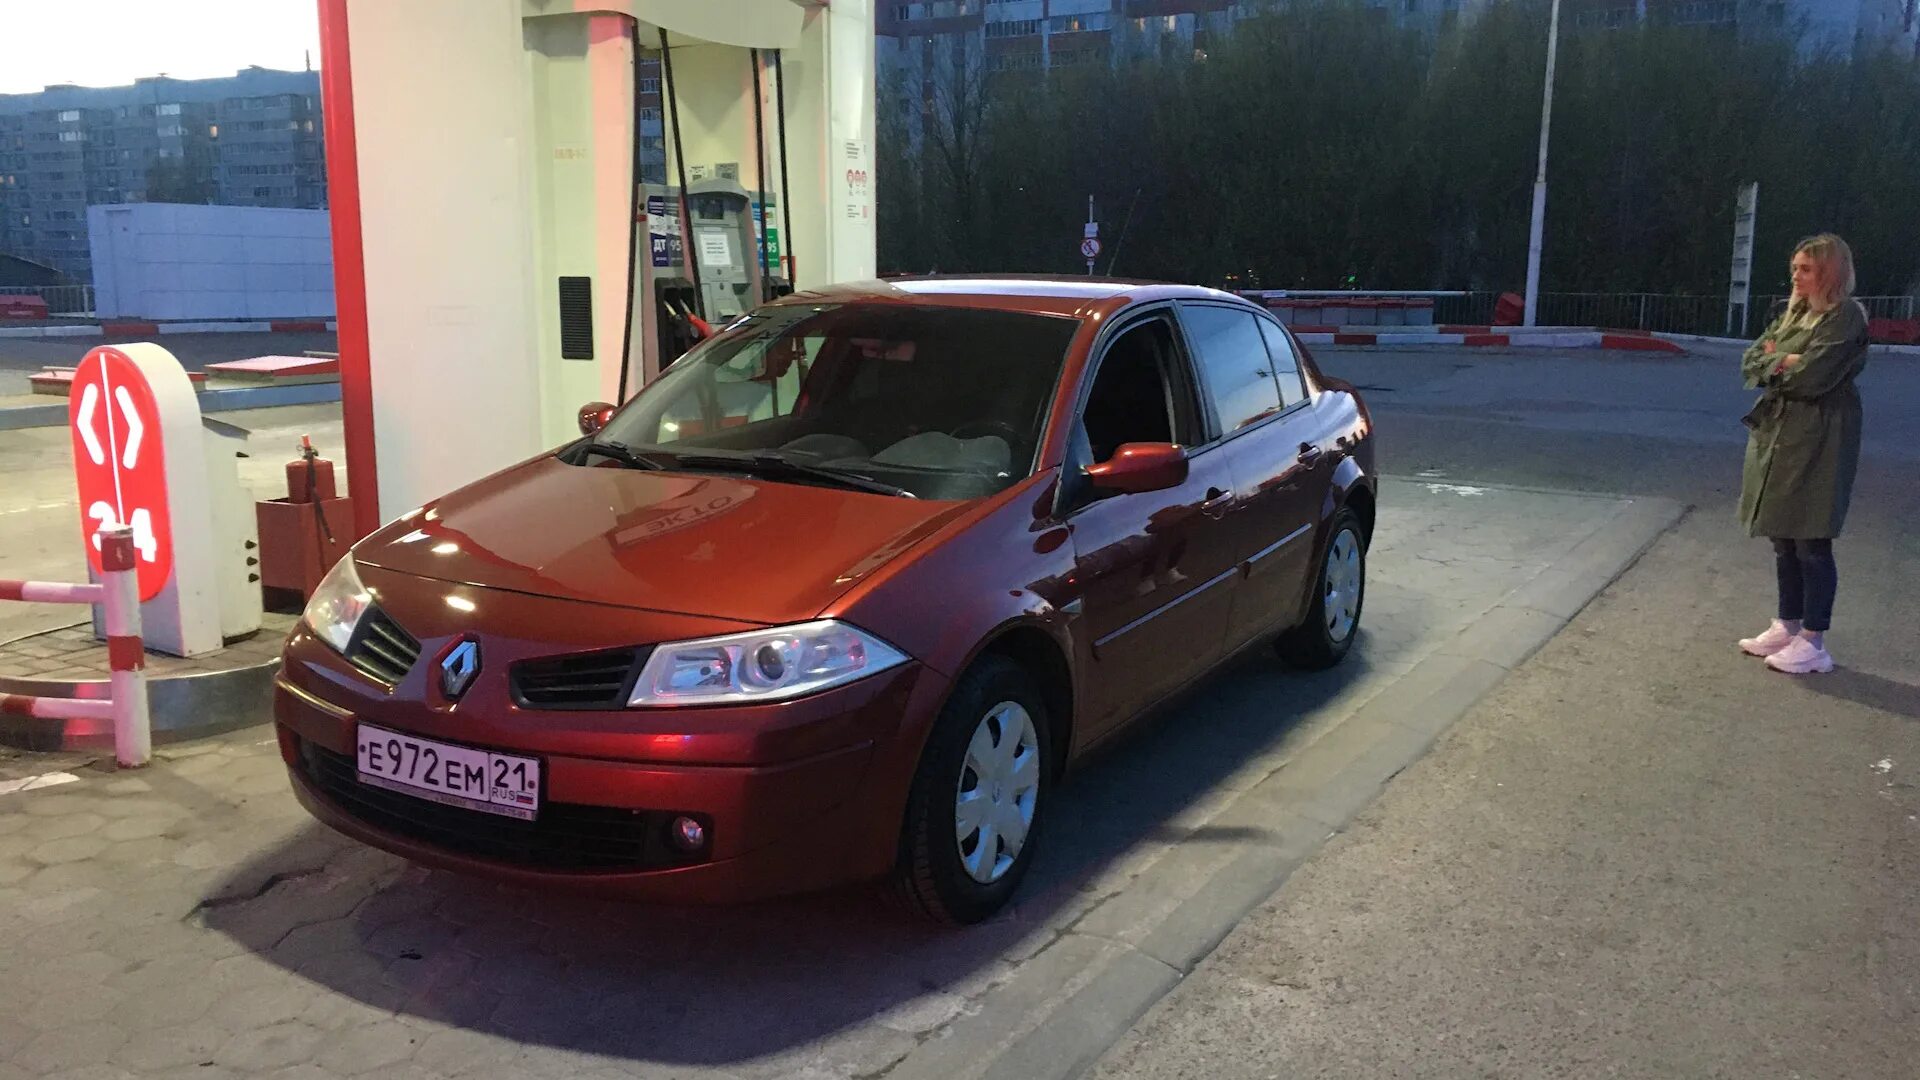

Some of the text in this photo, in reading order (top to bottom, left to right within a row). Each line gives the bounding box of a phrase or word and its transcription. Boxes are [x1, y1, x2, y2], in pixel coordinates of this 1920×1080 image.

[653, 238, 667, 253] ДТ
[368, 739, 485, 795] Е972ЕМ
[494, 759, 527, 791] 21
[491, 786, 515, 801] RUS
